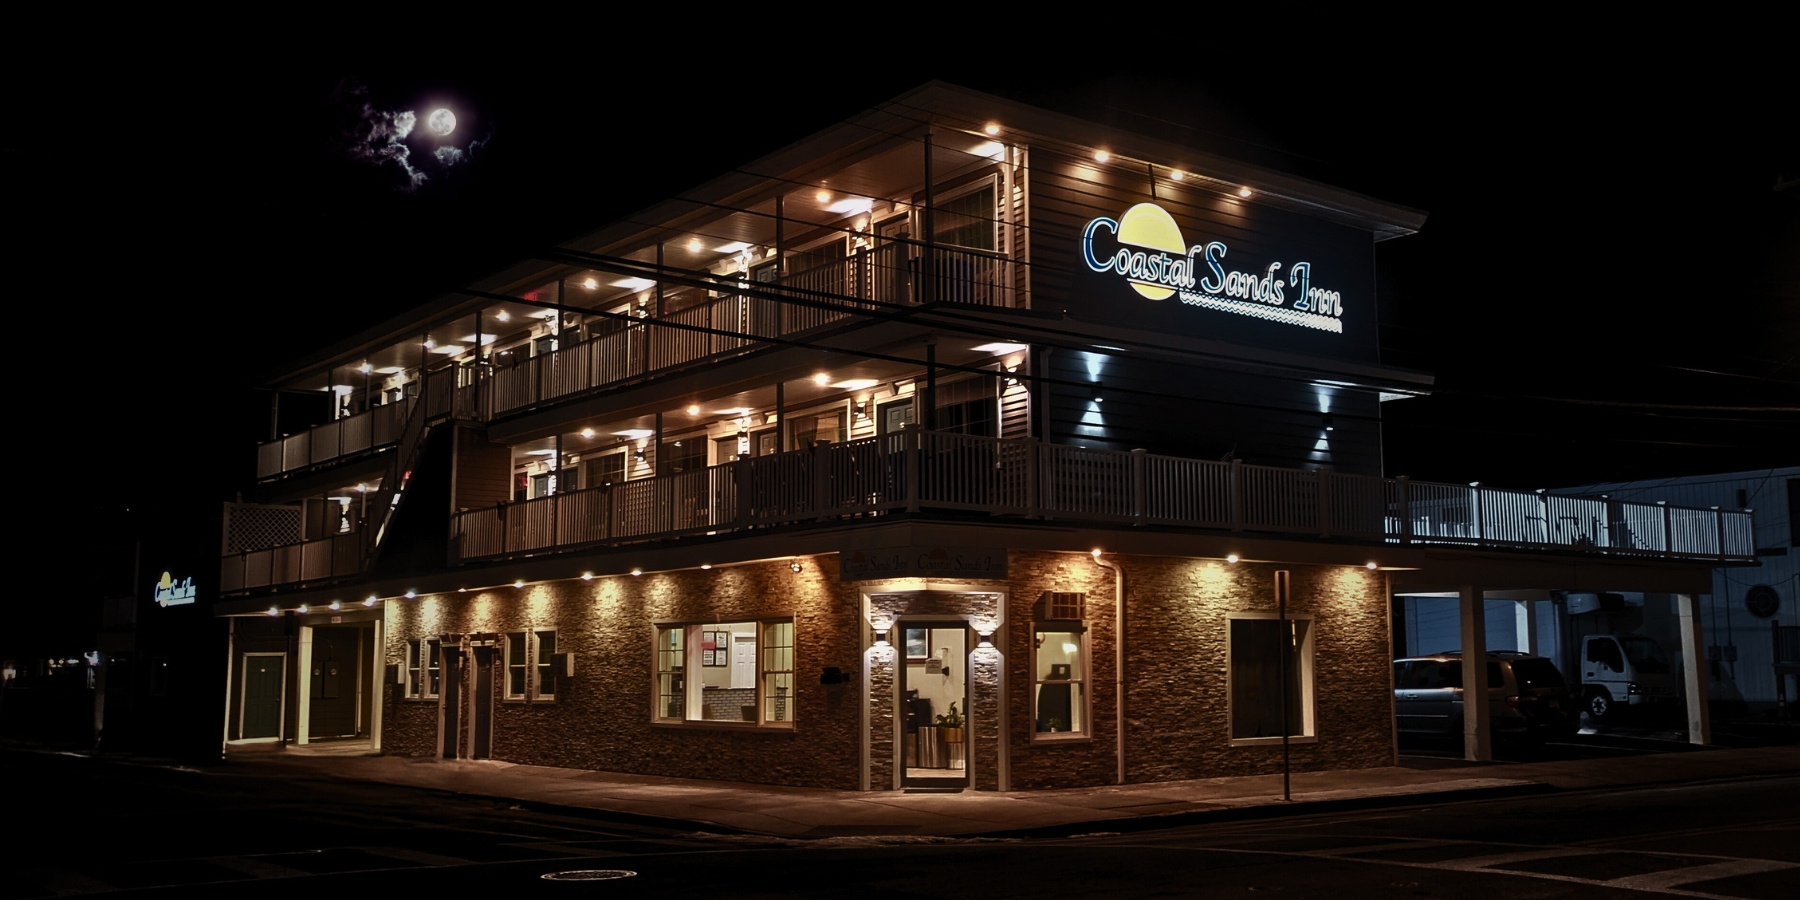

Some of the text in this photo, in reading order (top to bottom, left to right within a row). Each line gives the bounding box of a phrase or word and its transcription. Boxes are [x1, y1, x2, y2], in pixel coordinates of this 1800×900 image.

[1082, 216, 1344, 317] Coastal Sands Inn
[917, 554, 1002, 571] Coastal Sands Inn
